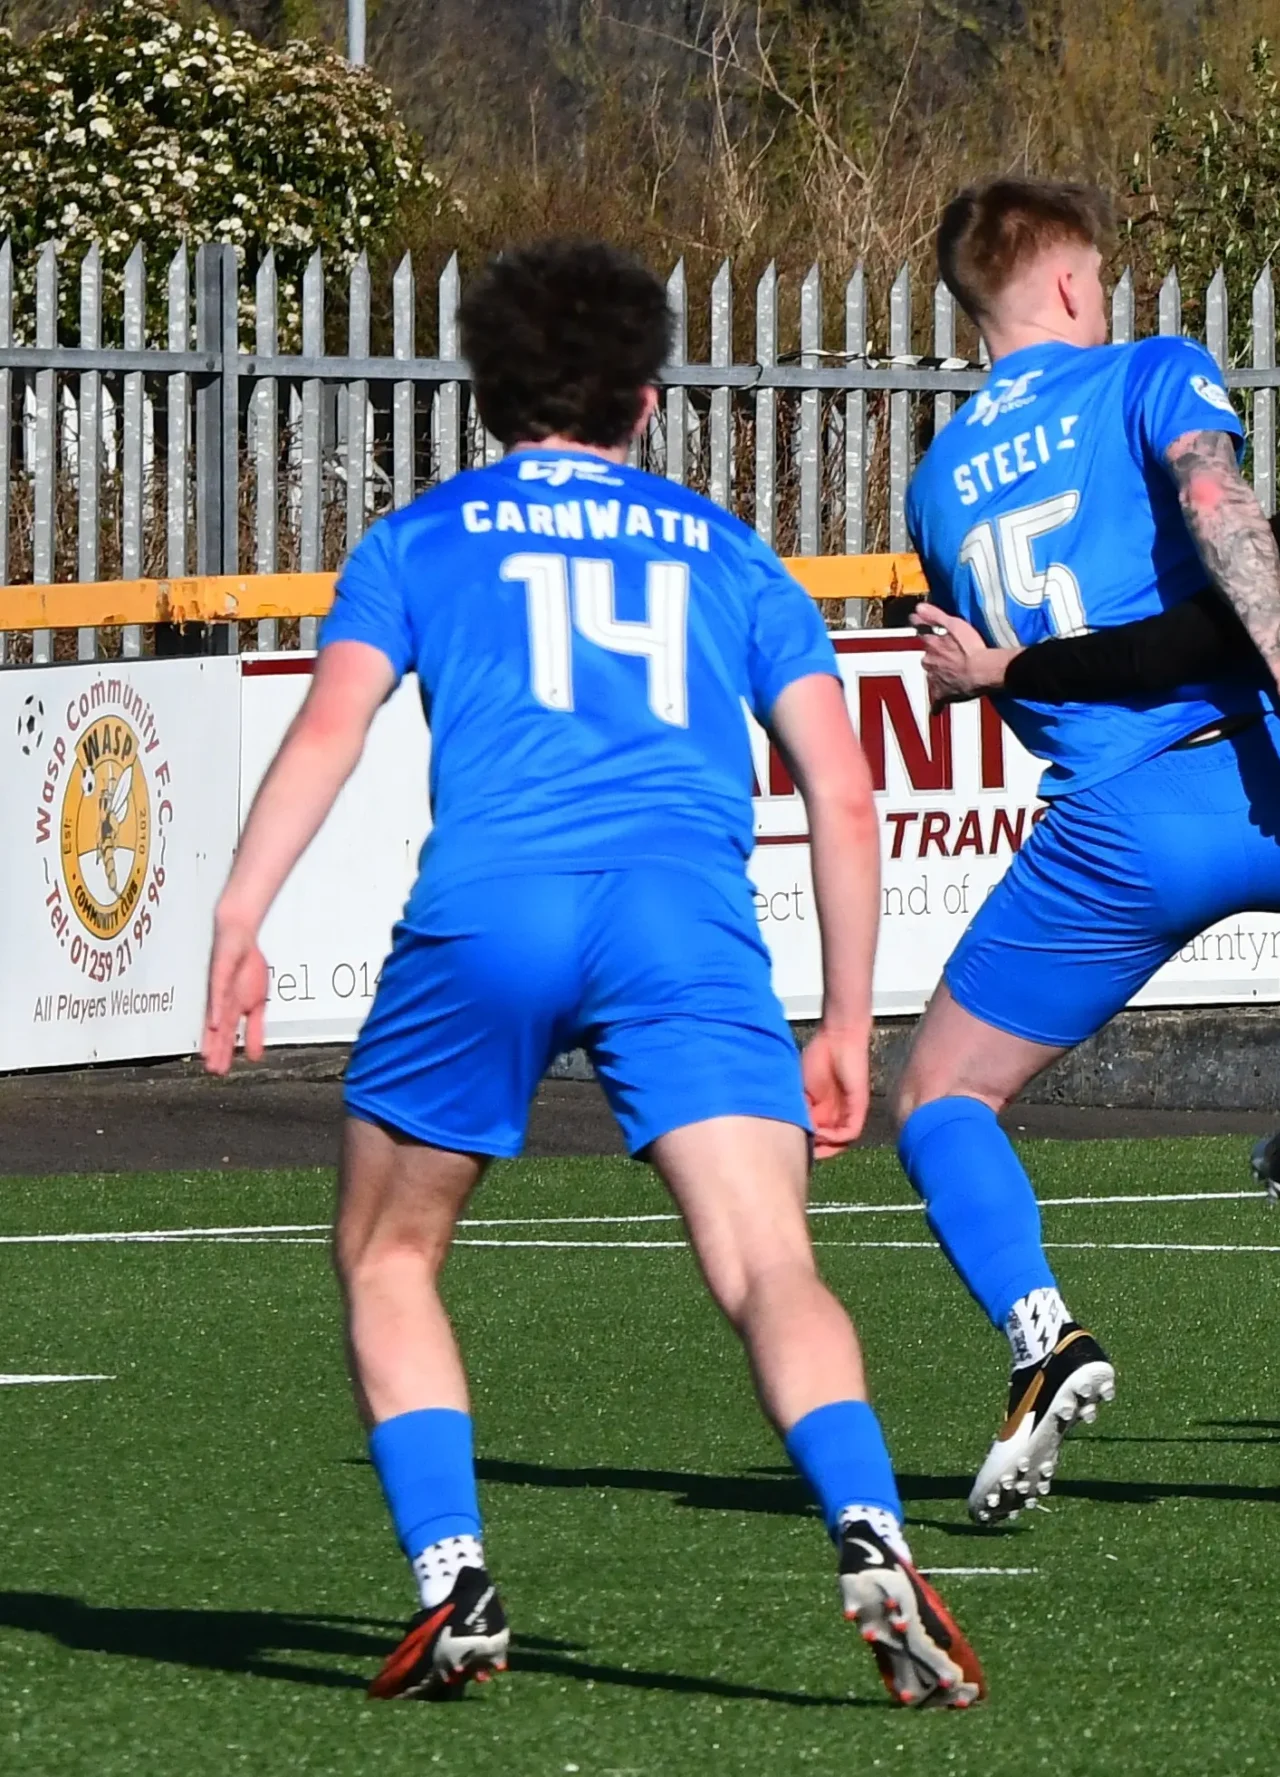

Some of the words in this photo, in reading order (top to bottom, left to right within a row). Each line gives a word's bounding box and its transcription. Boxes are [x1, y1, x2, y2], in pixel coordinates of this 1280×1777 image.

[462, 500, 710, 552] CARNWATH
[959, 489, 1080, 649] 15
[500, 552, 690, 729] 14
[36, 736, 66, 844] Wasp
[66, 678, 160, 754] Community
[82, 723, 133, 768] WASP
[138, 808, 147, 855] 2010
[886, 807, 1047, 859] TRAN
[46, 879, 70, 948] Tel:
[70, 934, 113, 983] 01259
[116, 937, 132, 977] 21
[133, 904, 152, 950] 95
[147, 863, 166, 907] 96
[74, 884, 120, 931] COMMUNITY
[120, 879, 139, 918] CLUB
[752, 883, 805, 922] ect
[883, 874, 930, 916] nd
[943, 873, 970, 915] of
[33, 996, 53, 1023] All
[56, 993, 107, 1024] Players
[110, 985, 175, 1017] Welcome!
